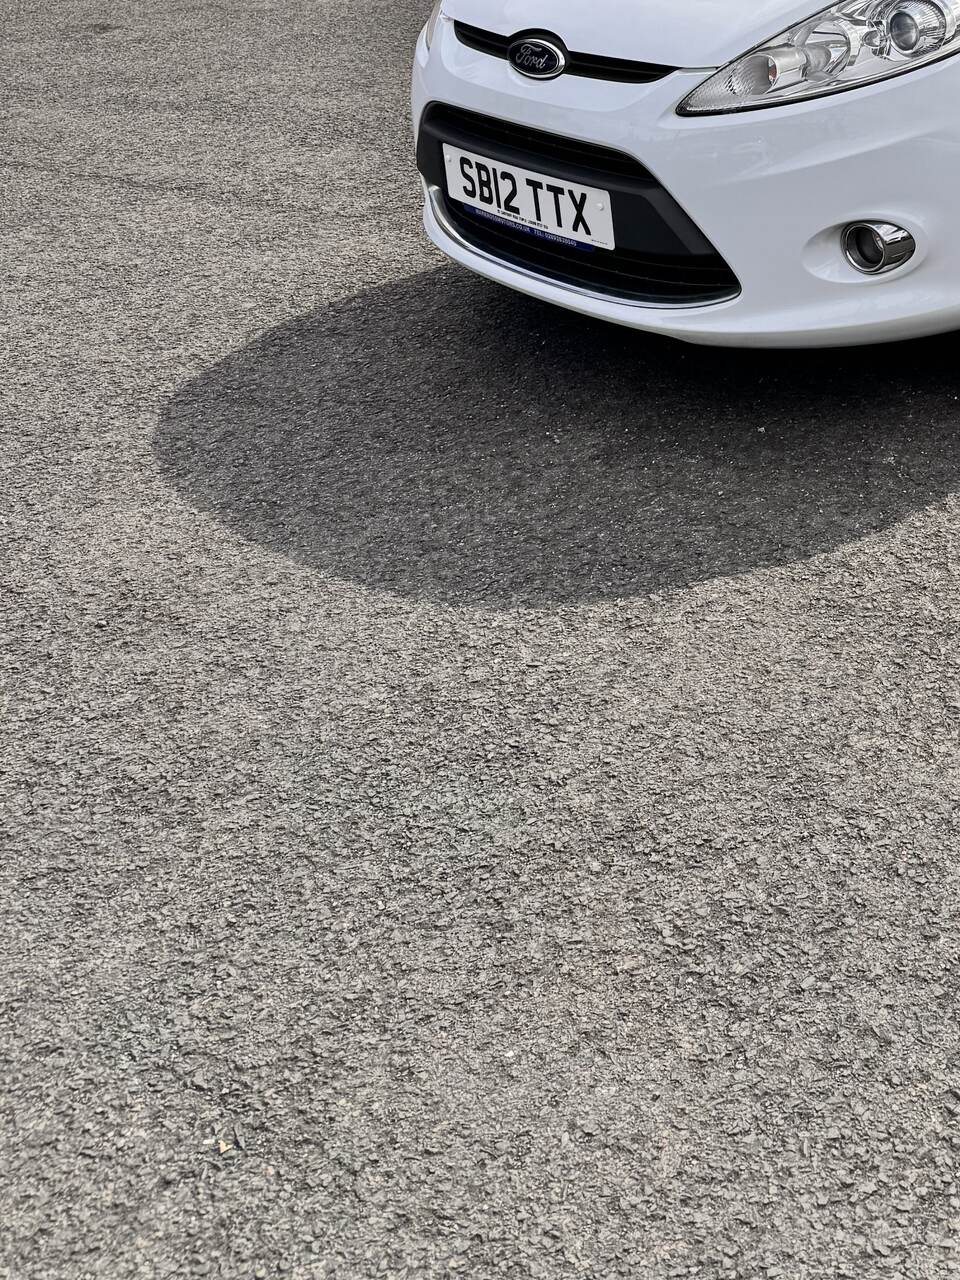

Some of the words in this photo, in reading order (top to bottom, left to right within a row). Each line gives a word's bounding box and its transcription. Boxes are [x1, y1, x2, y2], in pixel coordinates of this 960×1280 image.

[515, 44, 549, 69] Ford
[459, 156, 520, 215] SB12
[526, 178, 592, 236] TTX
